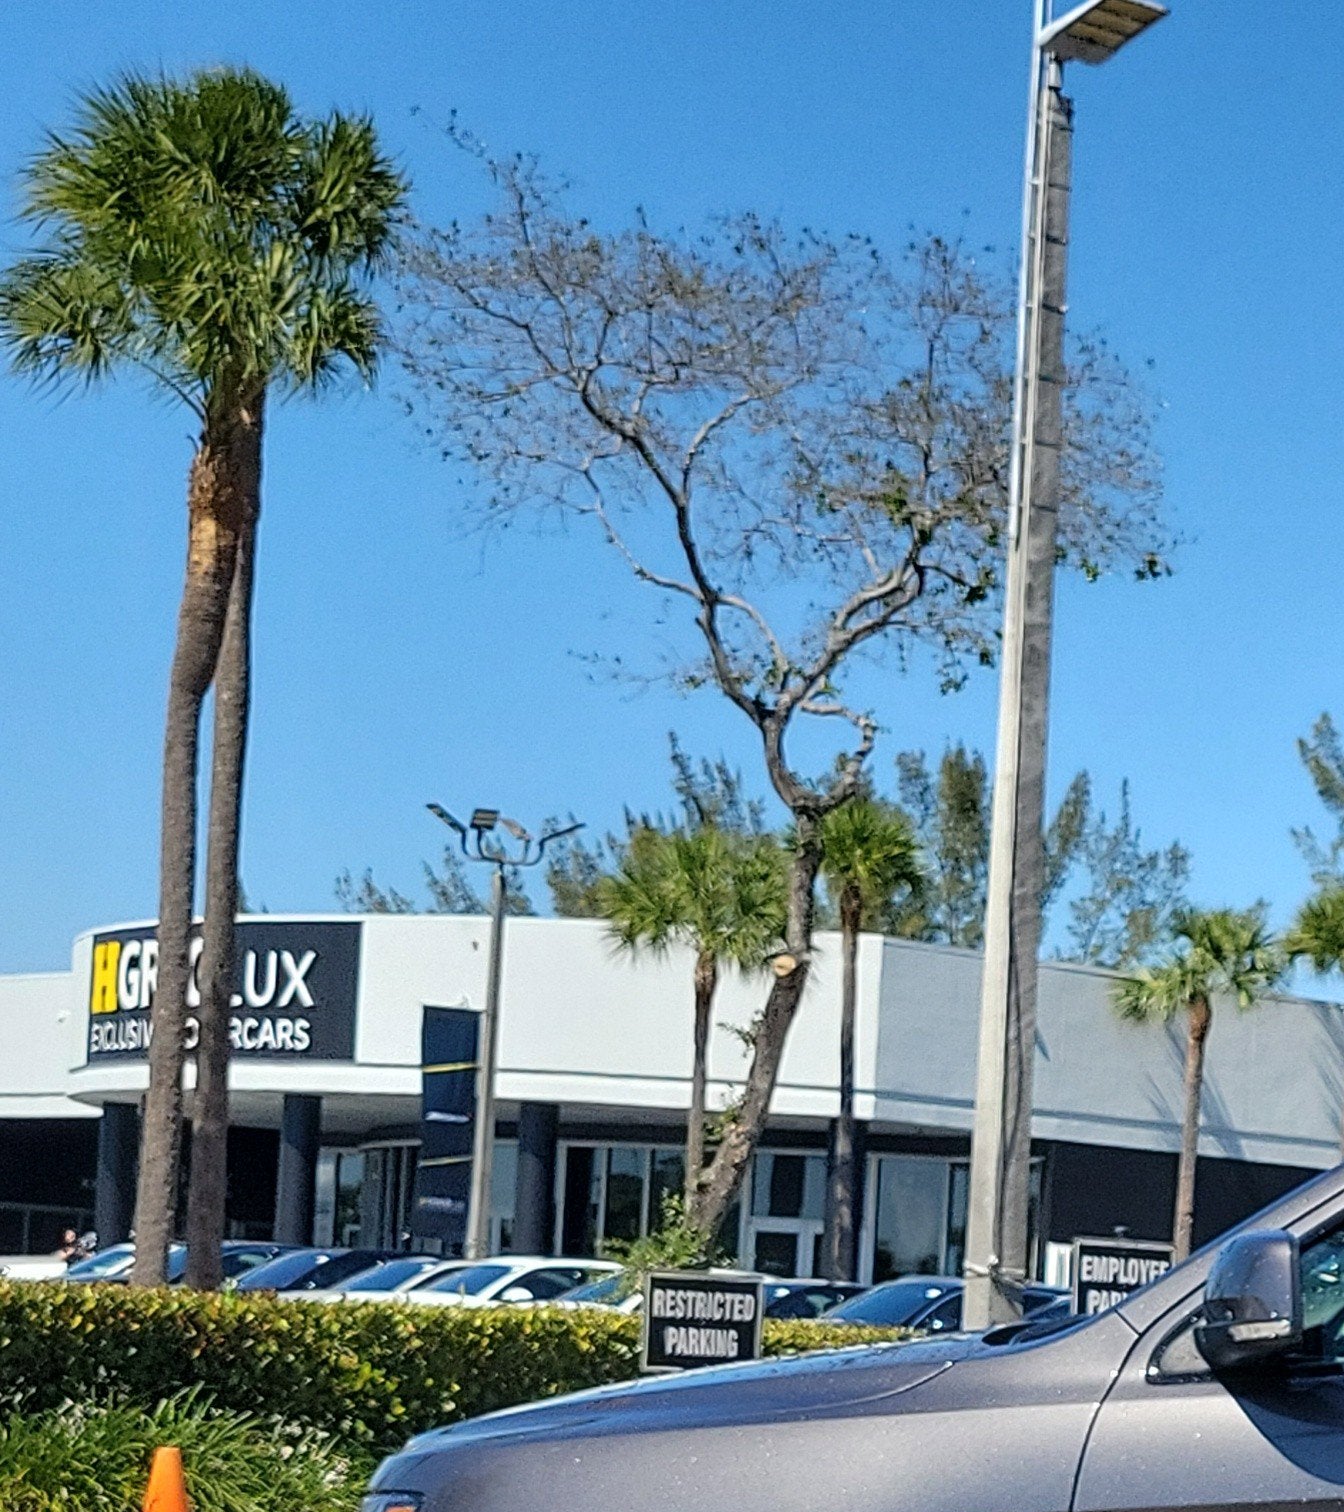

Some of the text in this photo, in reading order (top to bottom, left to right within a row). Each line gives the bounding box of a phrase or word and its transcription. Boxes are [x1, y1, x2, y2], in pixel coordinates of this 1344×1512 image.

[90, 1016, 155, 1052] EXCLUSIV
[652, 1288, 755, 1321] RESTRICTED
[664, 1326, 738, 1357] PARKING
